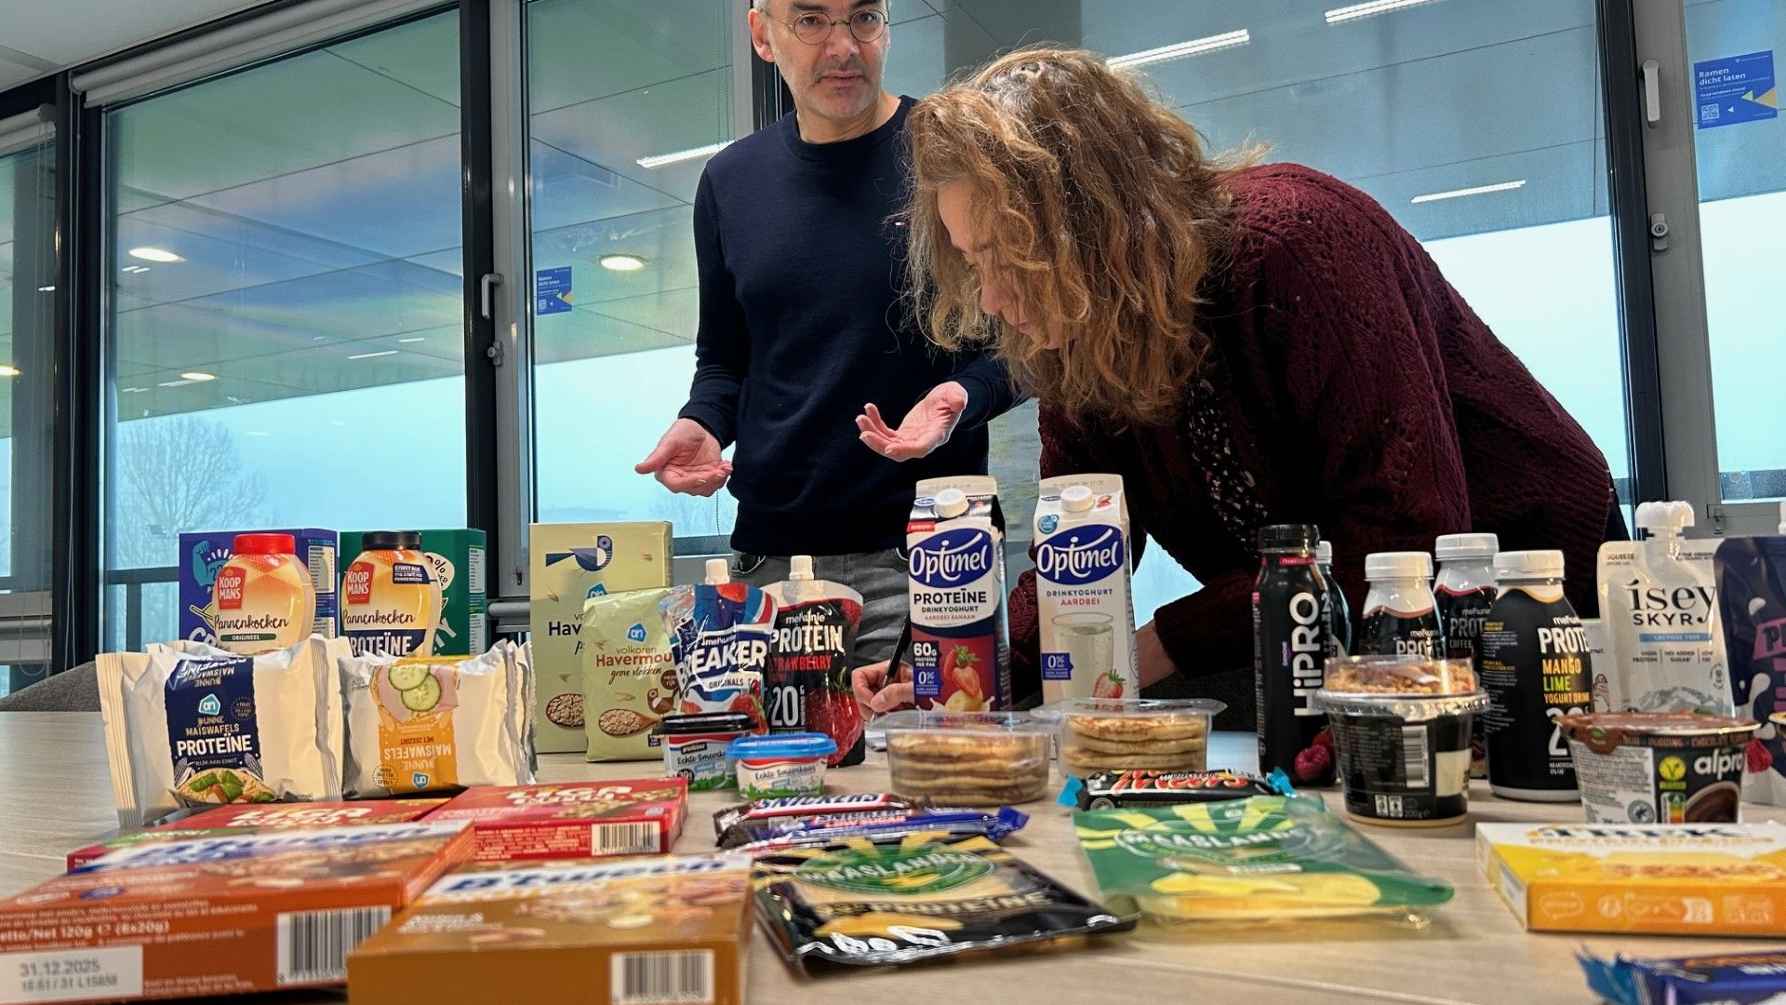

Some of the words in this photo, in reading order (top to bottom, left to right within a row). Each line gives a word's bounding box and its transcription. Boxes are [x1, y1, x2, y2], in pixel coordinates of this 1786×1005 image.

[1698, 68, 1729, 79] Ramen
[1698, 77, 1721, 87] dicht
[1723, 72, 1747, 82] laten
[909, 532, 988, 583] Optimel
[1036, 528, 1119, 580] Optimel
[218, 576, 242, 589] KOOP
[346, 571, 370, 584] KOOP
[219, 588, 242, 601] MANS
[347, 582, 370, 596] MANS
[1045, 588, 1113, 598] DRINKYOGHURT
[921, 605, 979, 613] DRINKYOGHURT
[1059, 597, 1101, 607] AARDBEI
[213, 614, 289, 631] Pannenkoeken
[342, 609, 416, 626] Pannenkoeken
[1632, 612, 1694, 626] SKYR
[1450, 617, 1488, 638] PROT
[351, 632, 413, 658] ROTEÏNE
[770, 624, 845, 654] PROTEIN
[1537, 627, 1590, 654] PROTE
[595, 652, 673, 668] Havermou
[1289, 592, 1327, 717] HiPRO
[1542, 656, 1582, 675] MANGO
[1543, 676, 1571, 692] LIME
[771, 685, 799, 726] 20
[185, 723, 240, 737] MAISWAFELS
[176, 733, 253, 757] PROTEÏNE
[383, 743, 452, 760] MAISWAFELS
[0, 926, 57, 943] etto/Net
[62, 923, 93, 940] 120g
[19, 958, 101, 978] 31.12.2025
